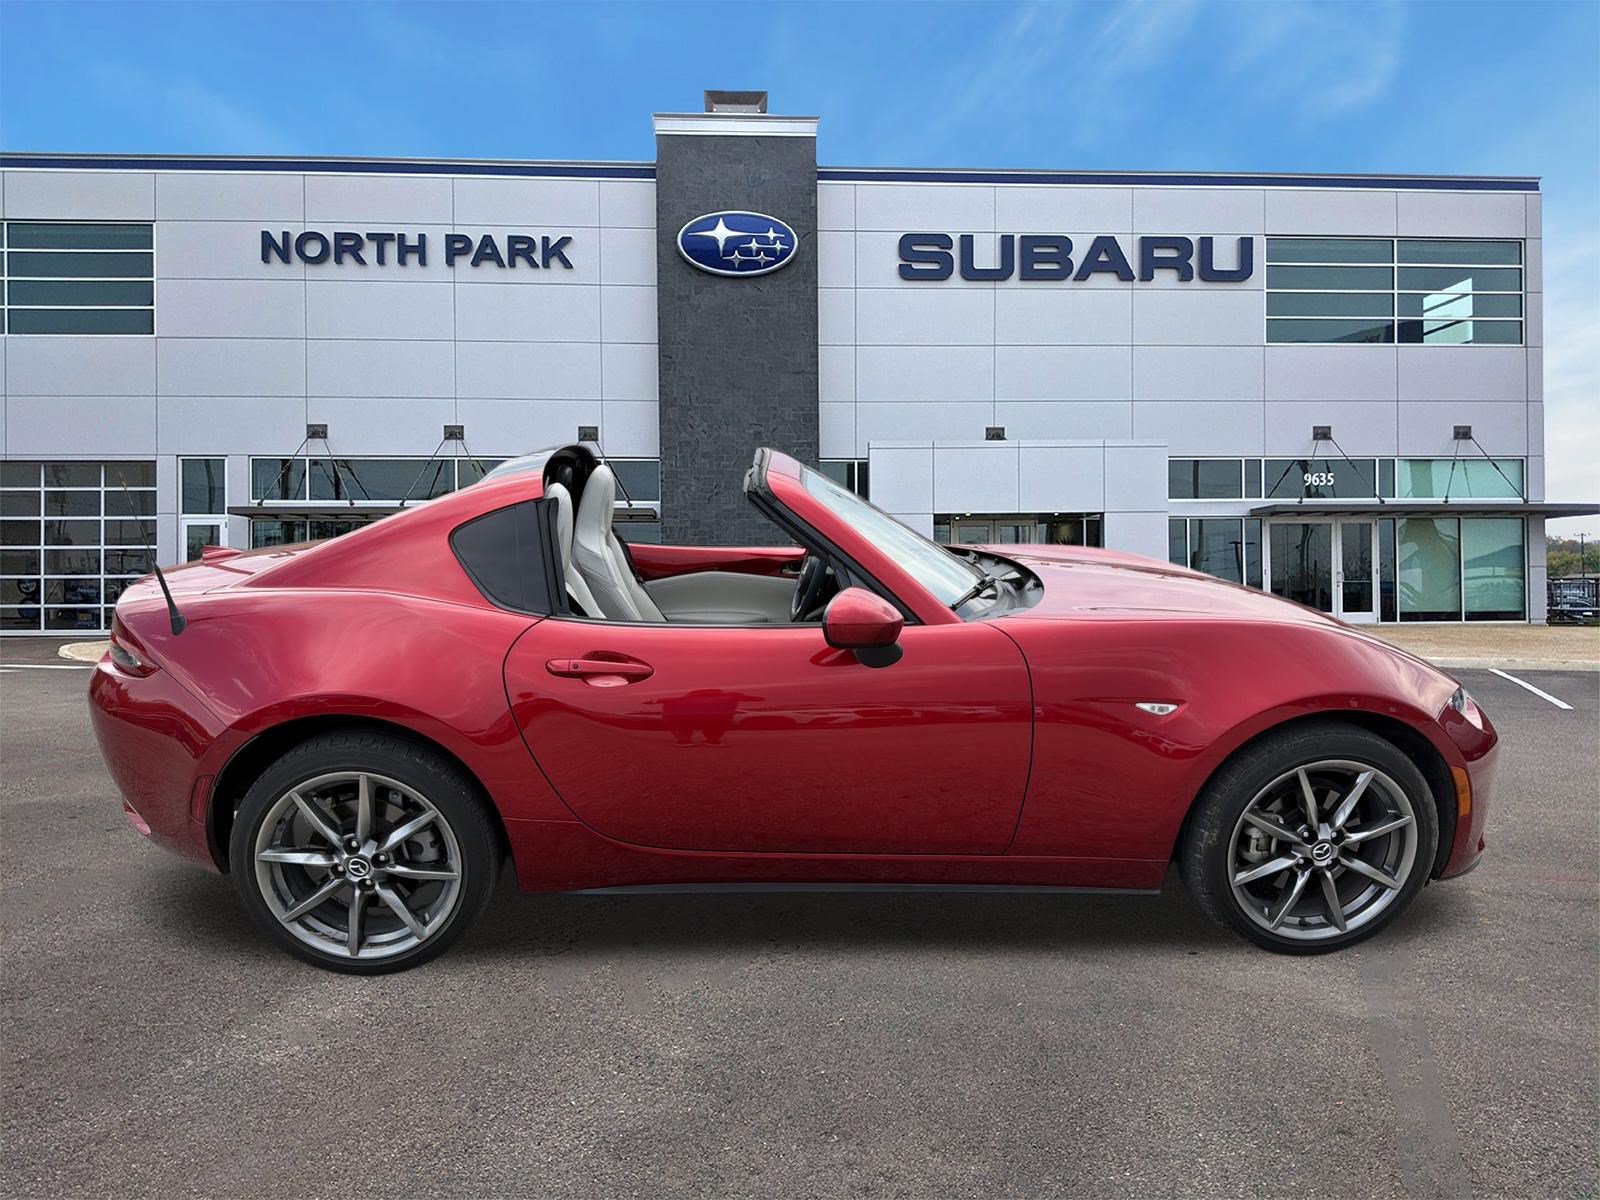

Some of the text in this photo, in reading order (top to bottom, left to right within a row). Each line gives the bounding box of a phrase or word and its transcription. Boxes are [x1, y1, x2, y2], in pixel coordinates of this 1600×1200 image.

[261, 230, 574, 269] NORTH PARK
[898, 233, 1254, 282] SUBARU
[1303, 472, 1335, 486] 9635
